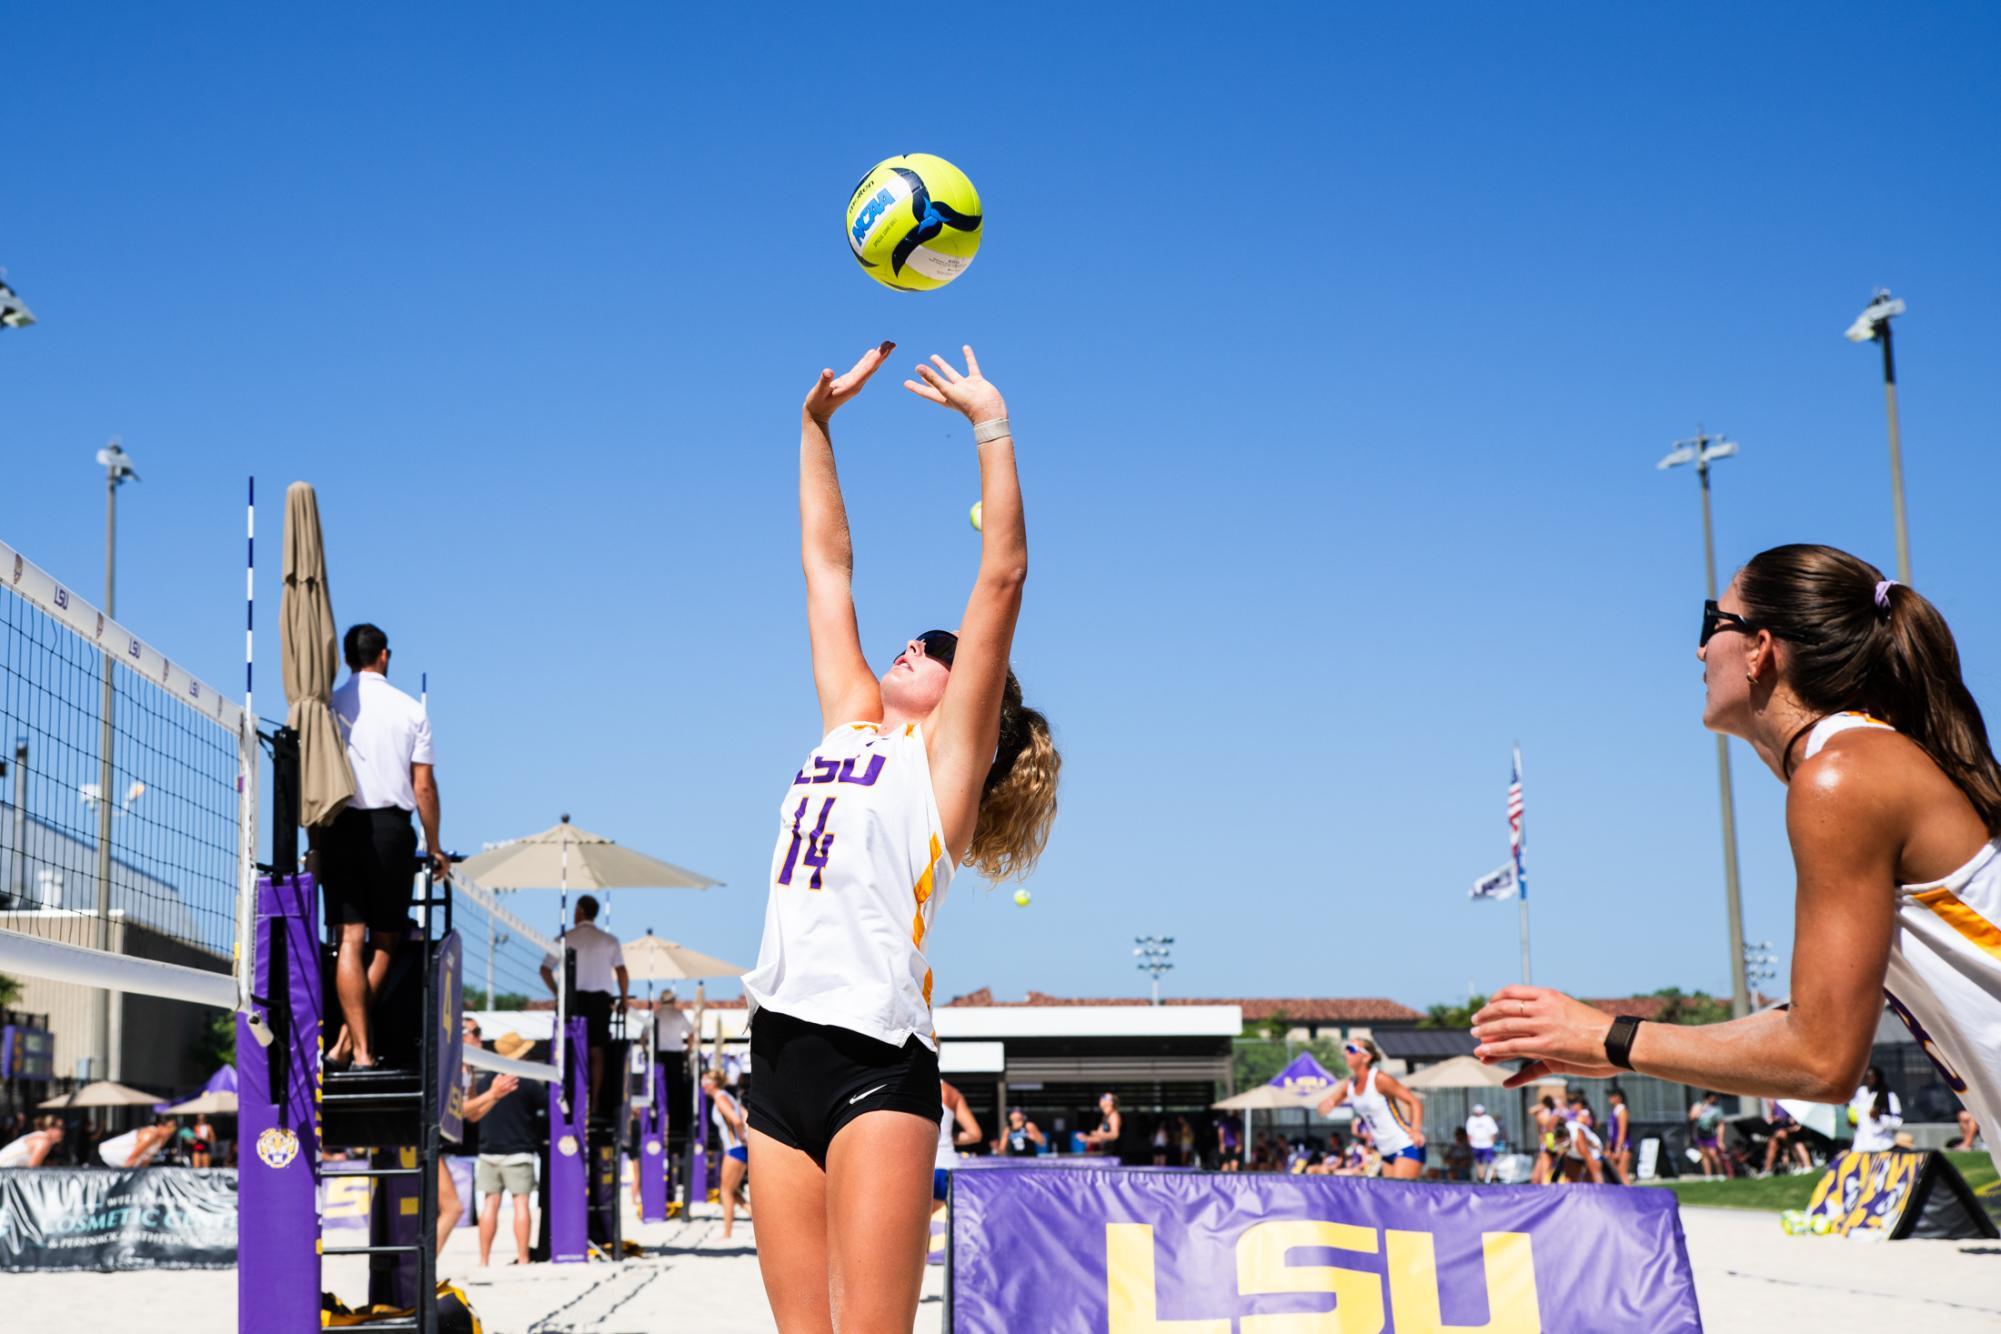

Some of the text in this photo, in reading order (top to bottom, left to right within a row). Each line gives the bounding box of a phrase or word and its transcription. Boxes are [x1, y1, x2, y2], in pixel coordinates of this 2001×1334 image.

[851, 187, 896, 247] NCAA
[54, 585, 69, 610] LSU
[793, 753, 887, 787] LSU
[777, 796, 837, 890] 14
[442, 969, 453, 1044] 4
[1105, 1219, 1542, 1334] LSU
